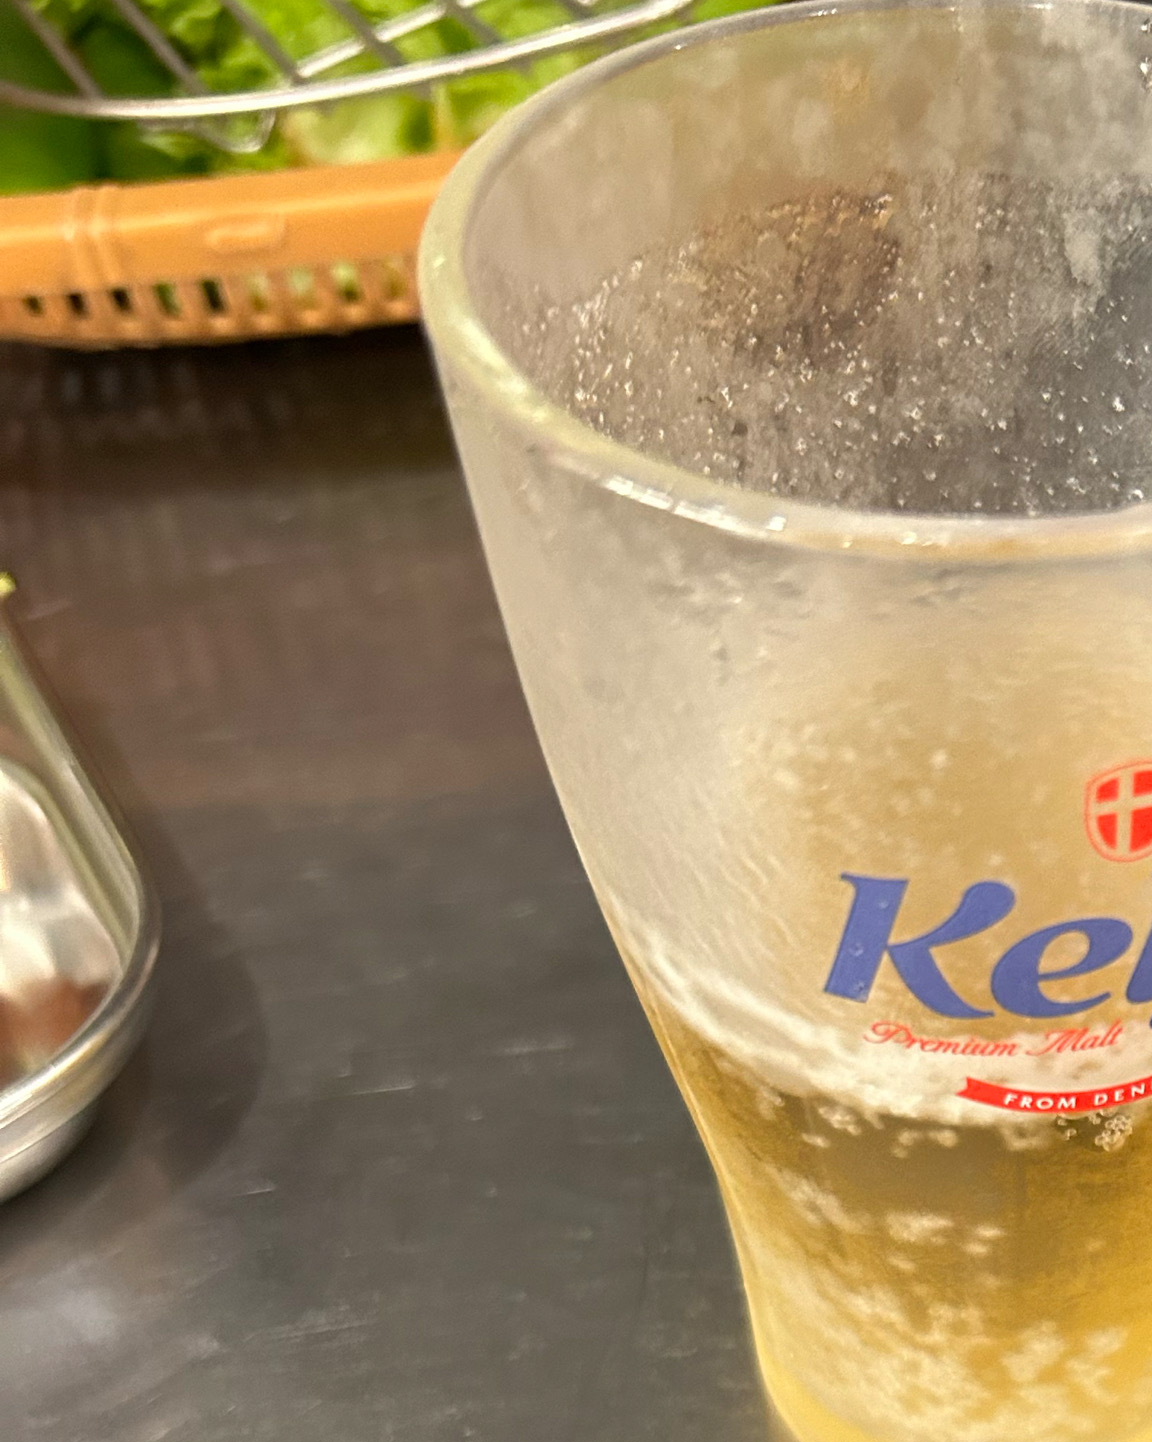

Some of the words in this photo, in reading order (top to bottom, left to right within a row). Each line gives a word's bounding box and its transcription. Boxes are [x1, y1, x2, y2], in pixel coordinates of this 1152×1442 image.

[863, 1021, 1017, 1057] Premium
[1026, 1019, 1124, 1057] Malt
[1003, 1092, 1078, 1111] FROM
